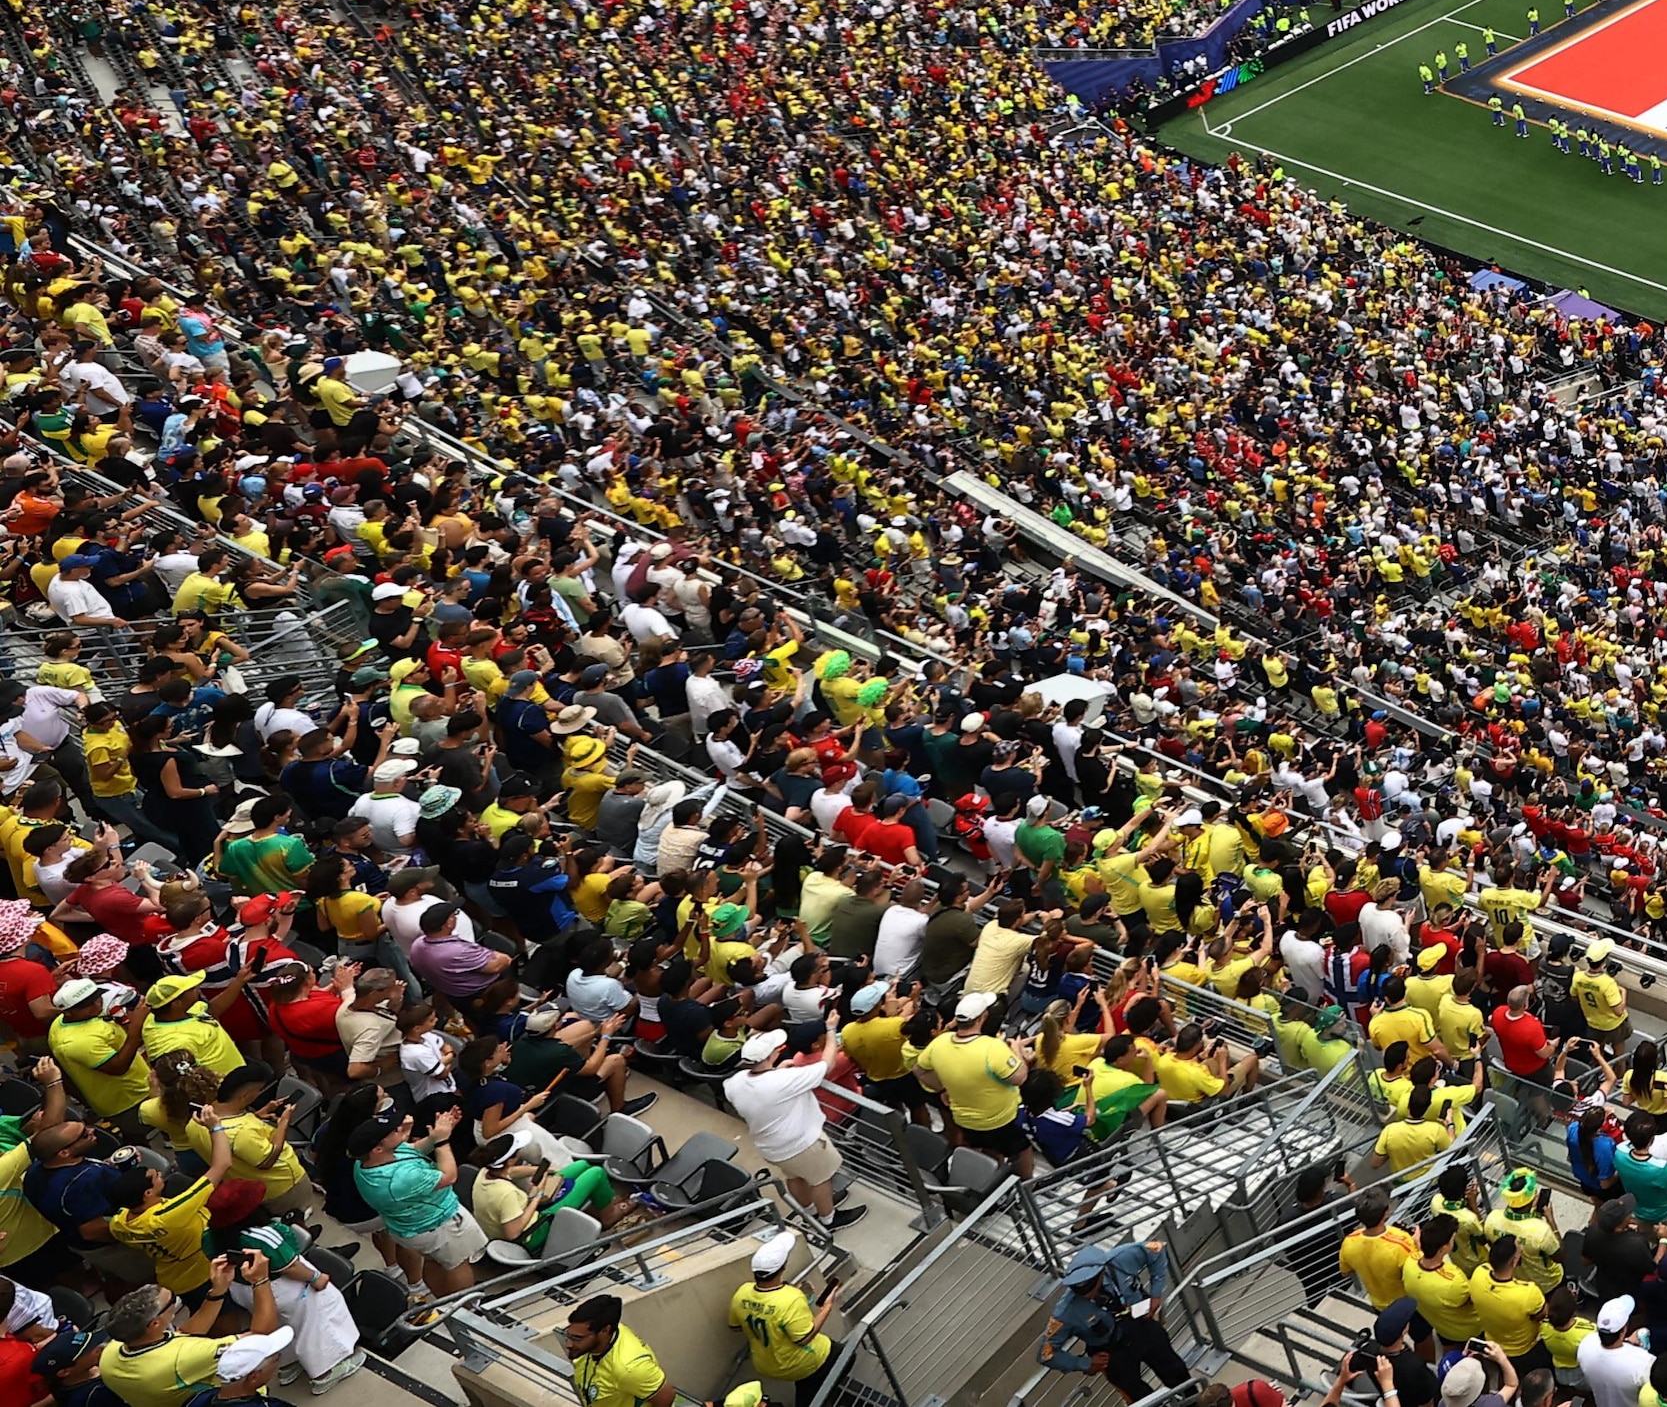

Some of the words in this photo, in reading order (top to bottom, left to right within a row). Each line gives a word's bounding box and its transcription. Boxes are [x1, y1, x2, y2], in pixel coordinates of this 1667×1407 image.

[1326, 11, 1362, 37] FIFA
[1494, 908, 1508, 925] 10
[1584, 991, 1598, 1008] 9
